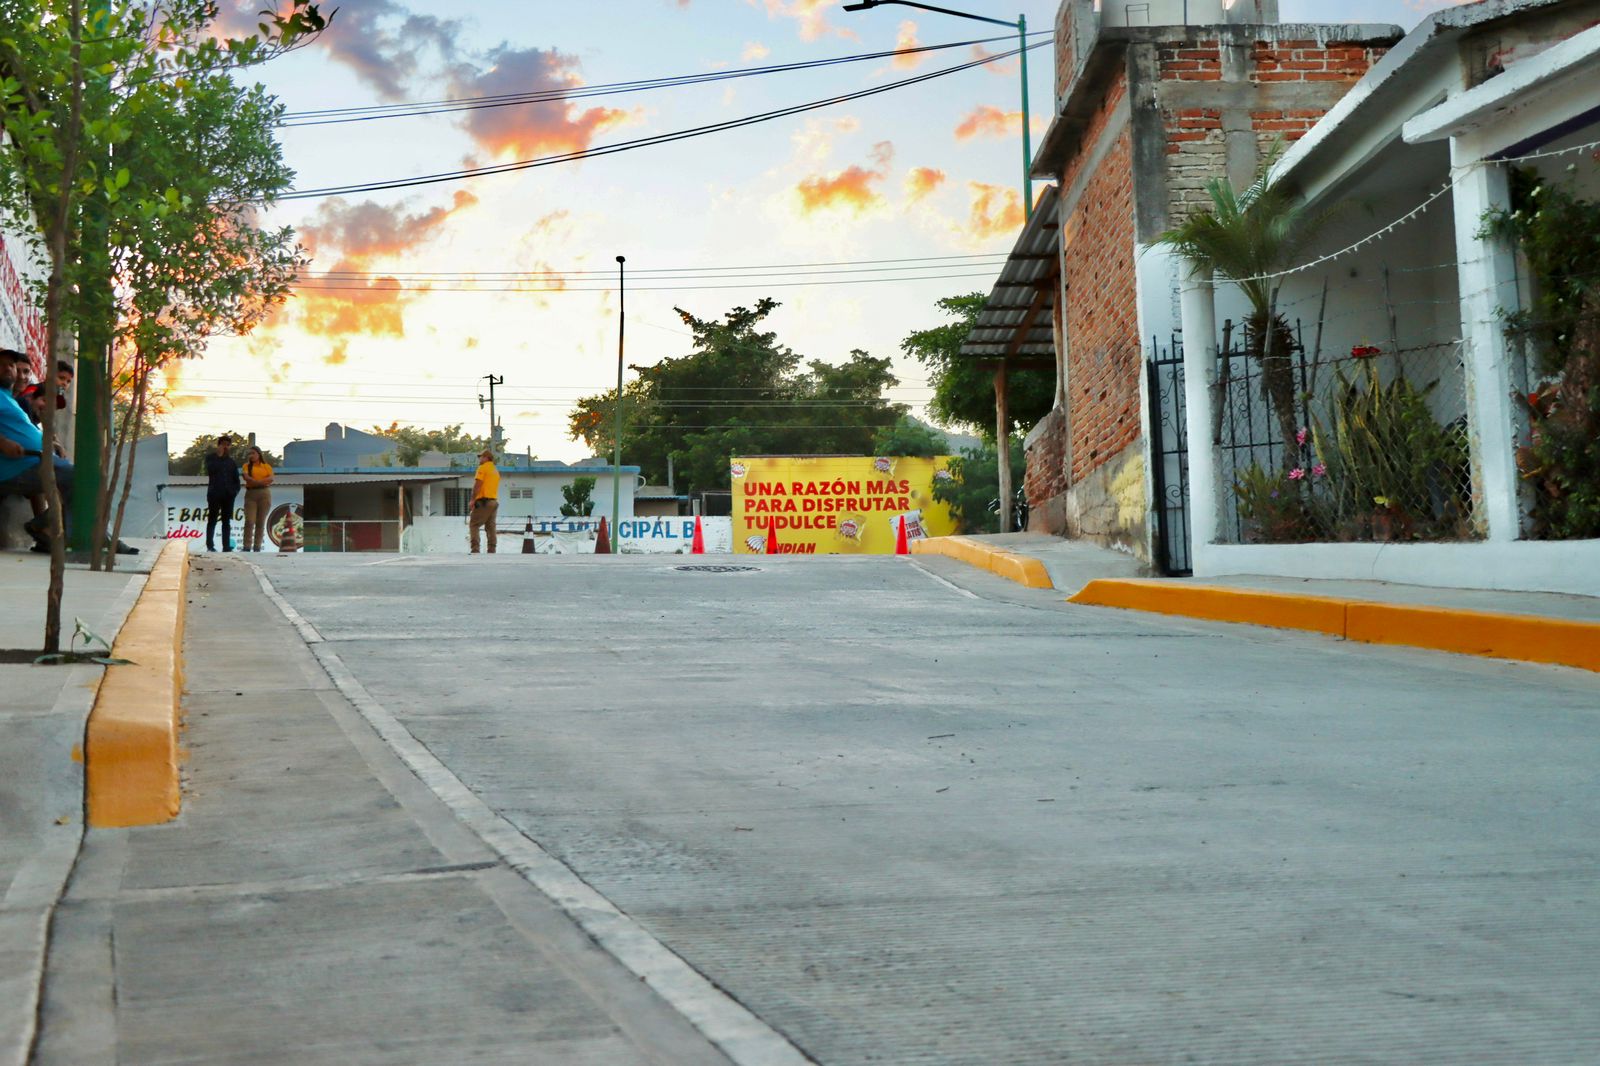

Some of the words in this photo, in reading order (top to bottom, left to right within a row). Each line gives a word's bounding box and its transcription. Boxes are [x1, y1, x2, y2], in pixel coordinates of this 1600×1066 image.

[743, 482, 787, 496] UNA
[792, 478, 860, 495] RAZÓN
[866, 480, 910, 495] MAS
[744, 498, 798, 513] PARA
[802, 497, 911, 513] DISFRUTAR
[743, 515, 768, 530] TU
[774, 515, 837, 530] DULCE
[776, 543, 816, 554] NDIAN
